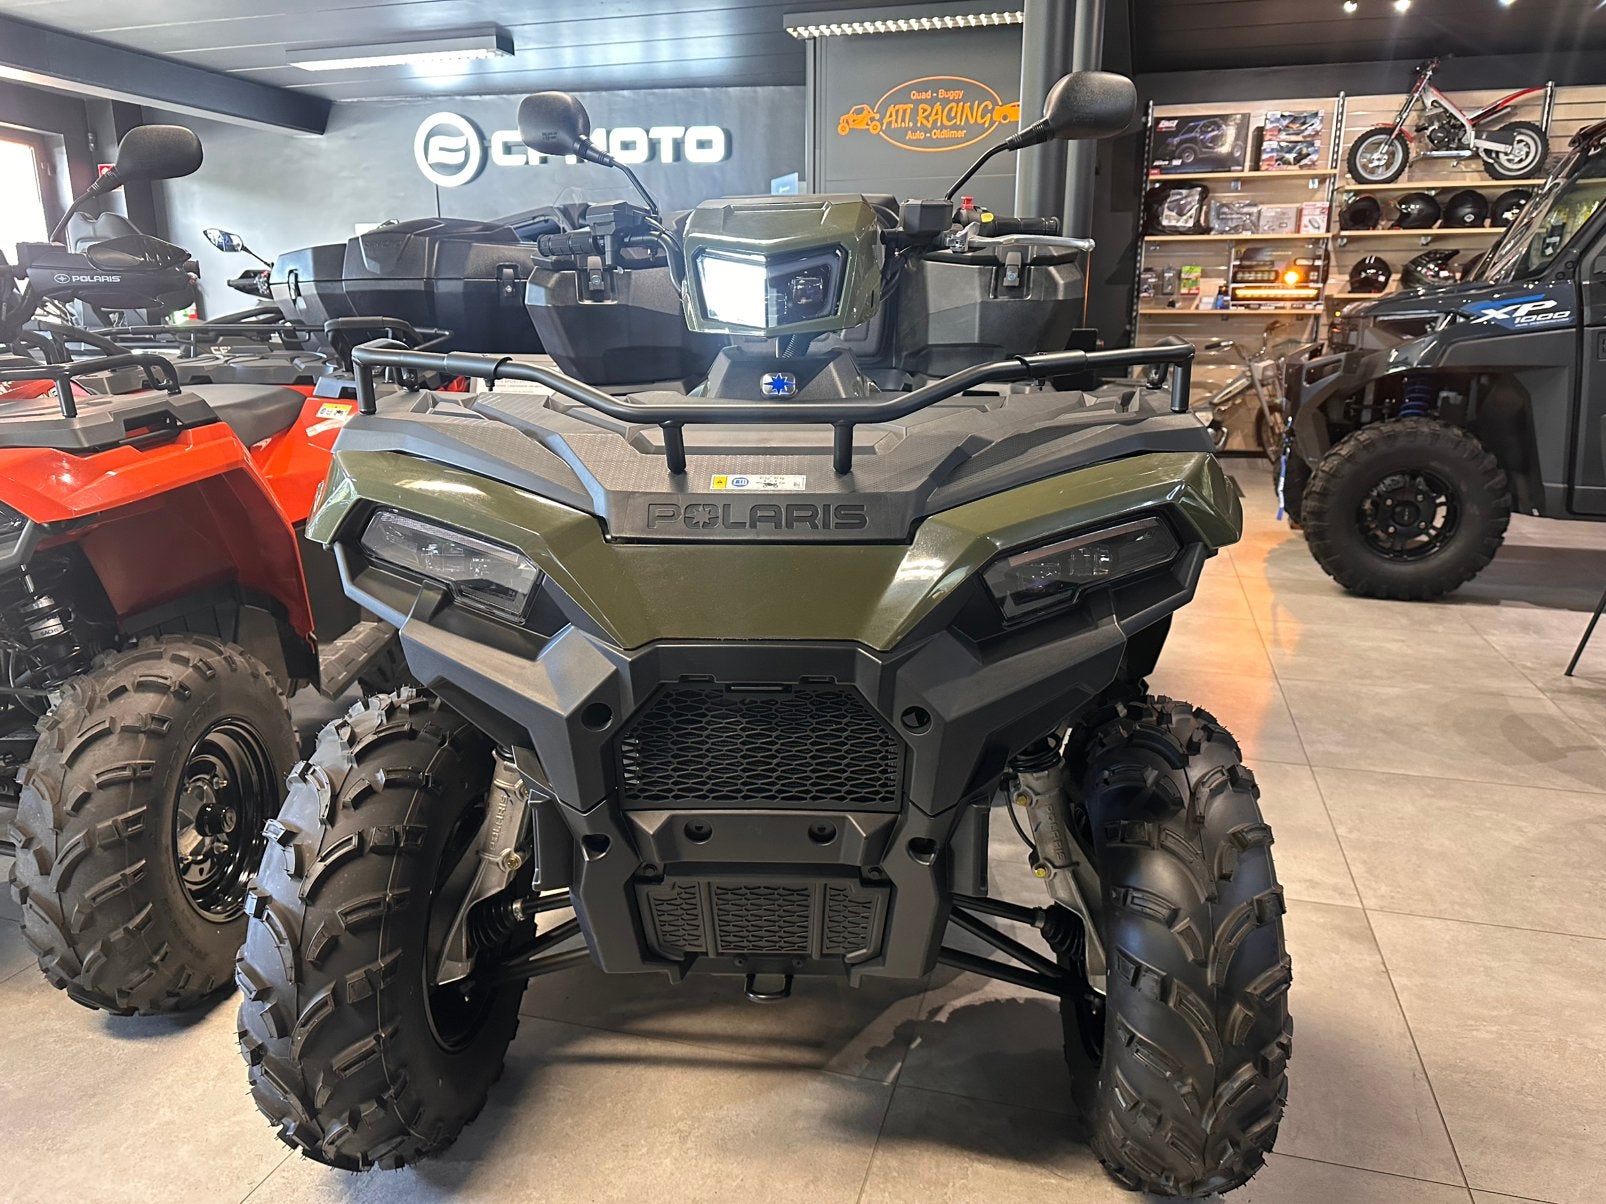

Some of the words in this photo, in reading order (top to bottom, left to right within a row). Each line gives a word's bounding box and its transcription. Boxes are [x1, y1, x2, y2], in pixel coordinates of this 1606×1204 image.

[910, 90, 932, 100] Quad
[938, 89, 964, 100] Buggy
[917, 100, 992, 128] RACING
[491, 126, 725, 165] COTO
[906, 130, 925, 140] Auto
[931, 129, 967, 139] Oldtimer
[1470, 300, 1558, 324] XP
[1514, 310, 1571, 324] 1000
[647, 503, 869, 530] POLARIS
[489, 794, 508, 850] POLARIS
